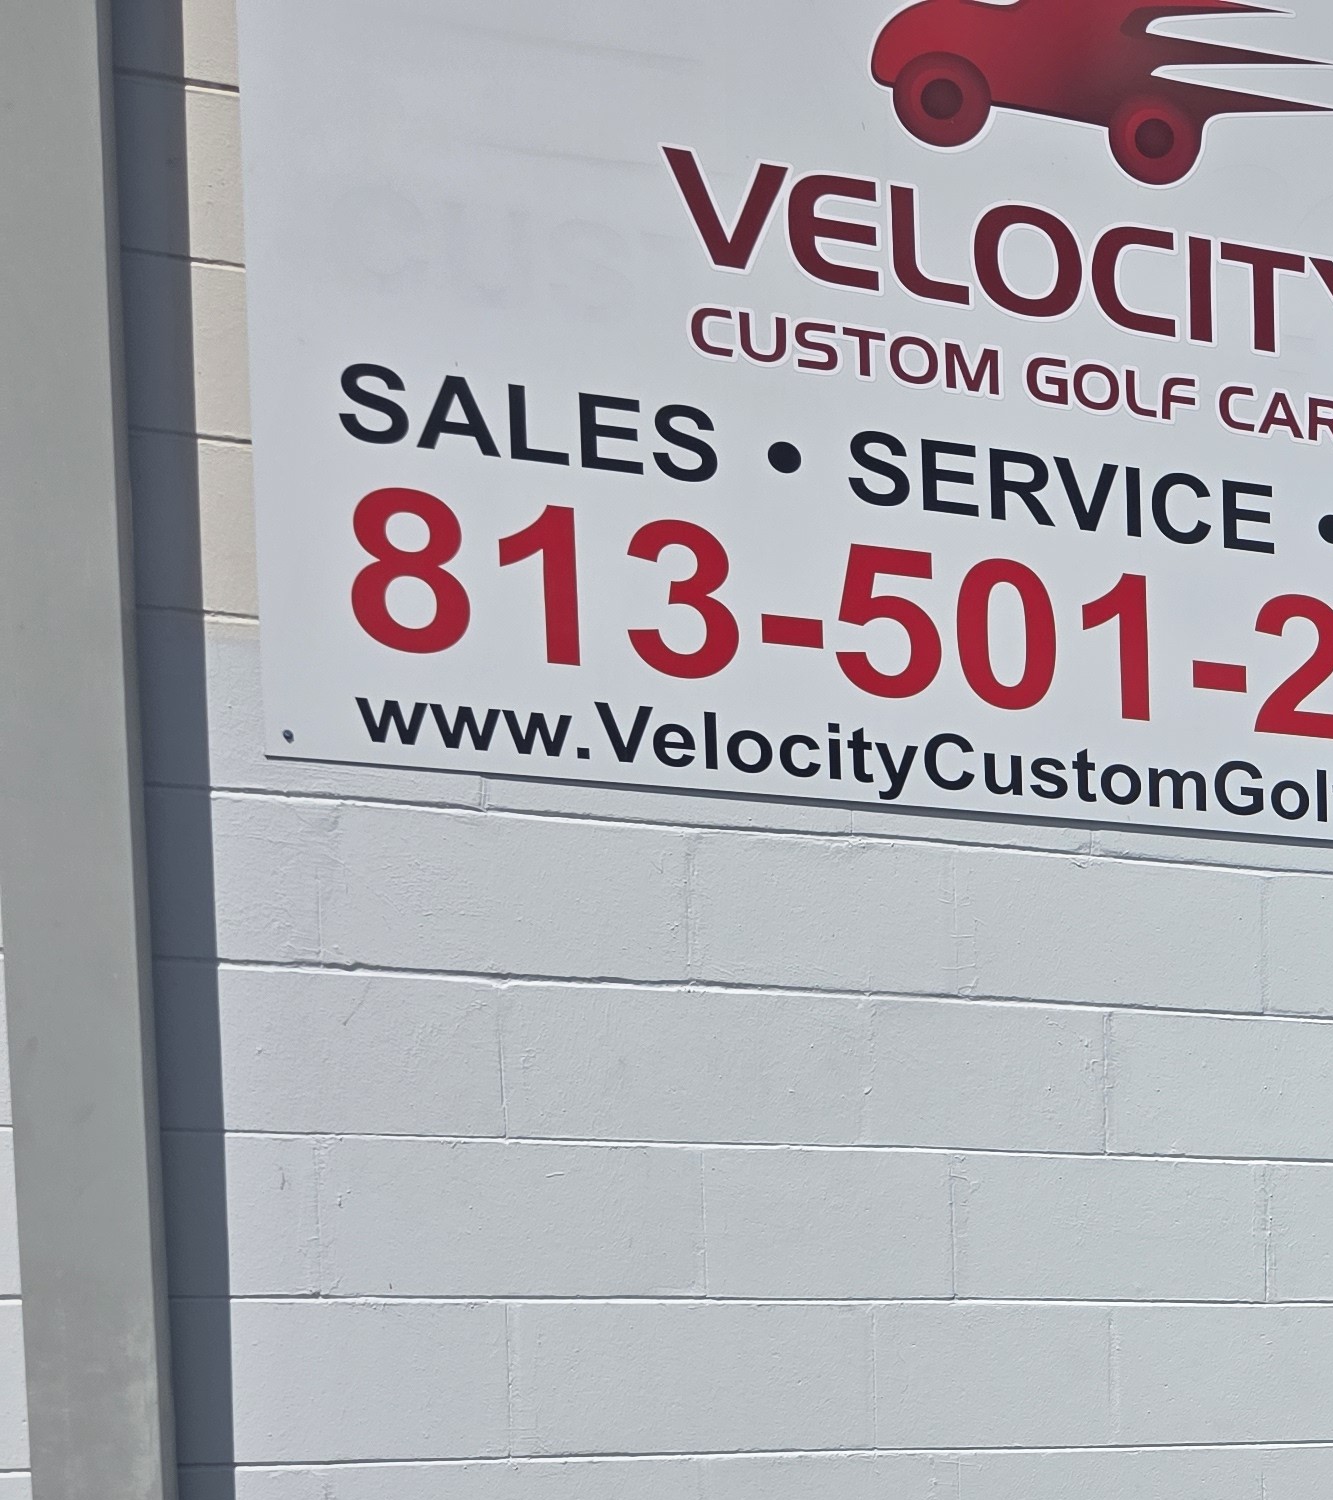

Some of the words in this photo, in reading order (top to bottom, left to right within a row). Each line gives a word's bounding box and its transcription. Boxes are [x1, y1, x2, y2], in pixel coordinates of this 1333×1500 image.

[690, 307, 1000, 400] CUSTOM
[1026, 356, 1196, 421] GOLF
[338, 362, 718, 483] SALES
[848, 430, 1276, 555] SERVICE
